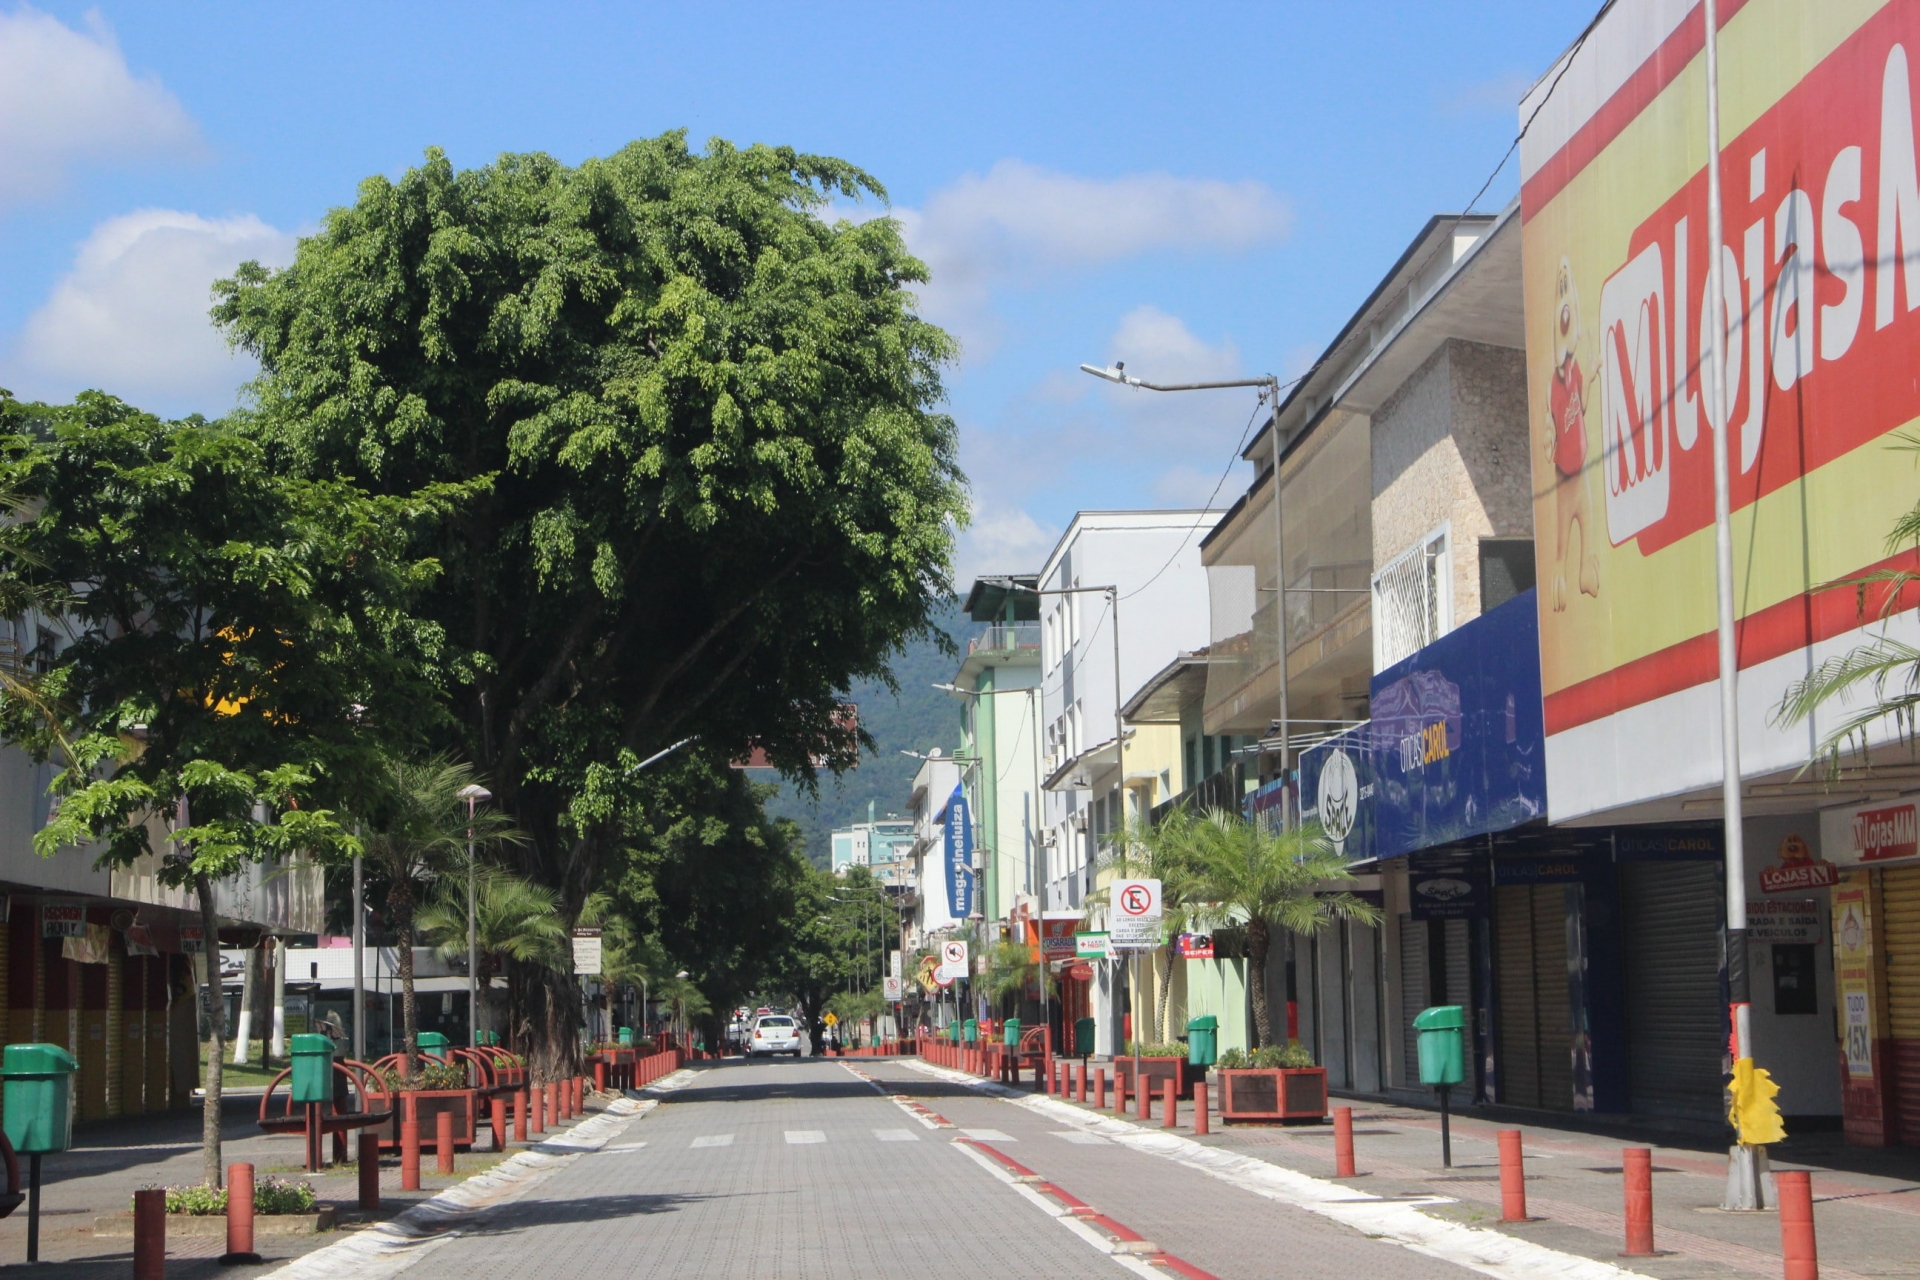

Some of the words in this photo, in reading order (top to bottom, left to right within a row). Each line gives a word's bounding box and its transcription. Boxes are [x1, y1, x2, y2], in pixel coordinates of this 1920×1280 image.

[1423, 719, 1450, 765] CAROL
[1325, 789, 1353, 840] SPACE
[1864, 810, 1916, 856] LojasMM
[1668, 838, 1715, 852] CAROL
[952, 804, 966, 911] magaineluiza
[1538, 864, 1579, 876] CAROL
[1764, 868, 1809, 885] LOJAS
[1425, 886, 1463, 897] SPACE
[1768, 902, 1818, 914] ESTACIONAR
[1847, 996, 1865, 1012] TUDO
[1847, 1025, 1869, 1061] 15X
